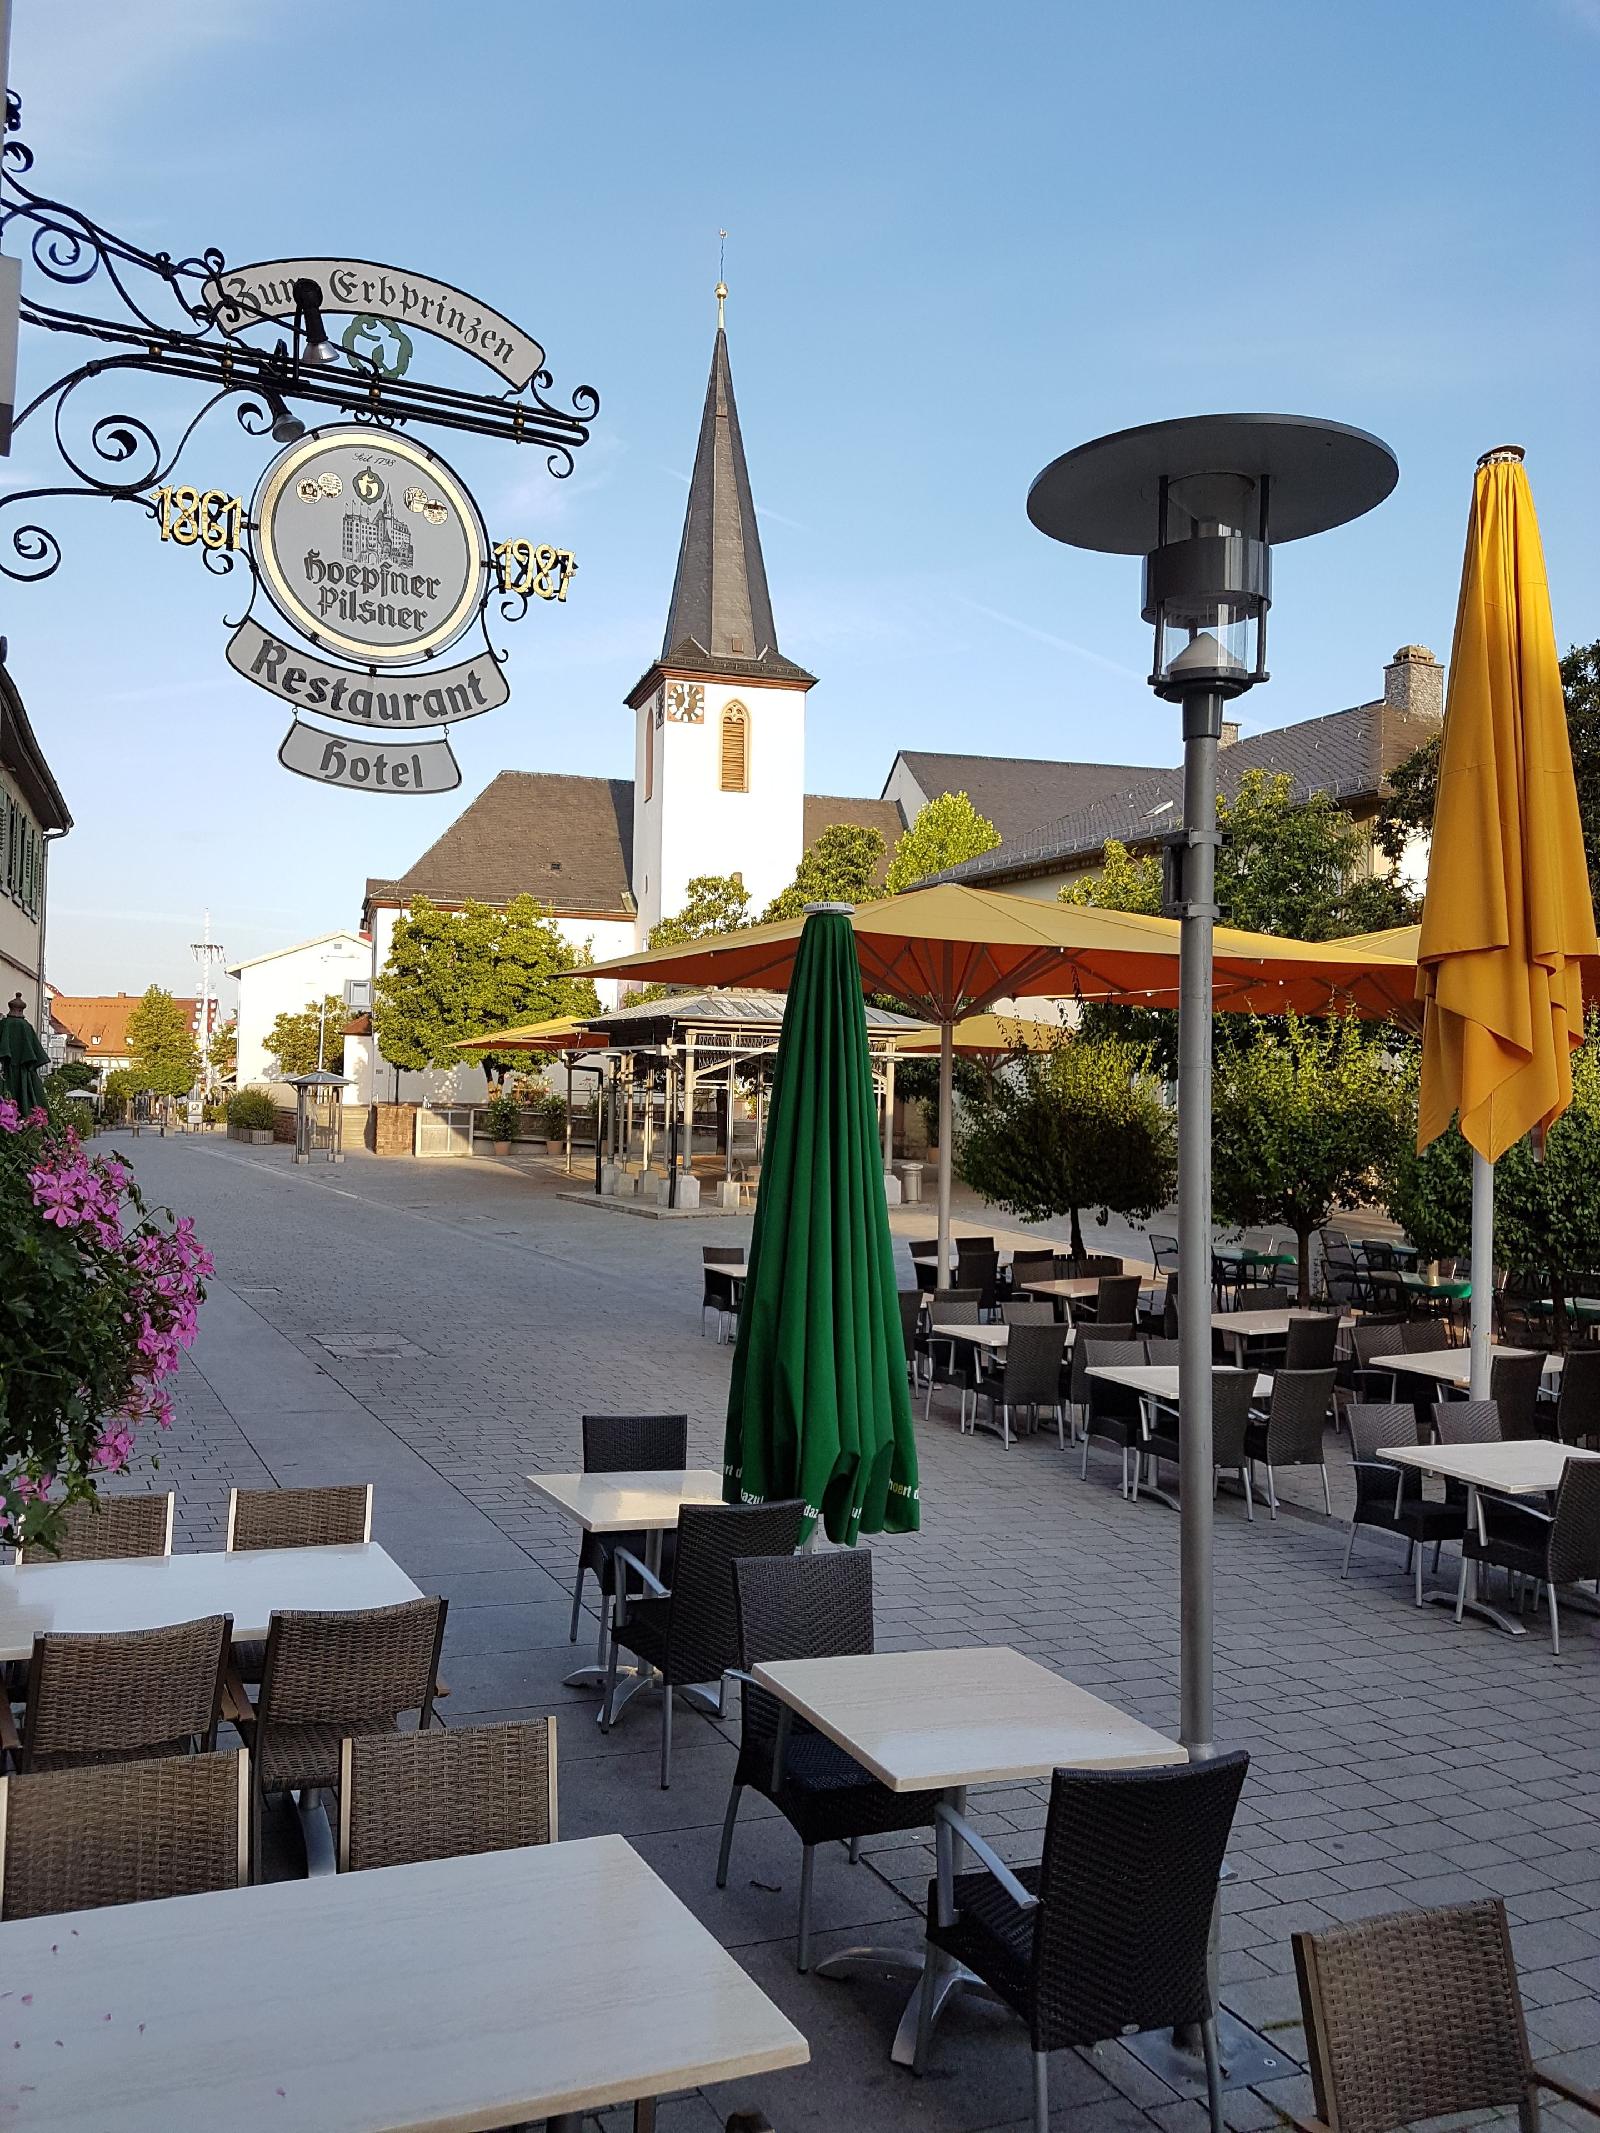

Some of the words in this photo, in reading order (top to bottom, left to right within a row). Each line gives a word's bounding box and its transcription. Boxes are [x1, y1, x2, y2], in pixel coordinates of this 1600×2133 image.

[329, 269, 517, 365] Erbprinzen
[352, 452, 374, 464] Seit
[148, 484, 243, 550] 1861
[303, 548, 442, 600] Hoepfner
[493, 537, 576, 602] 1987
[317, 585, 428, 633] Pilsner
[250, 638, 489, 722] Restaurant
[319, 741, 423, 790] Hotel
